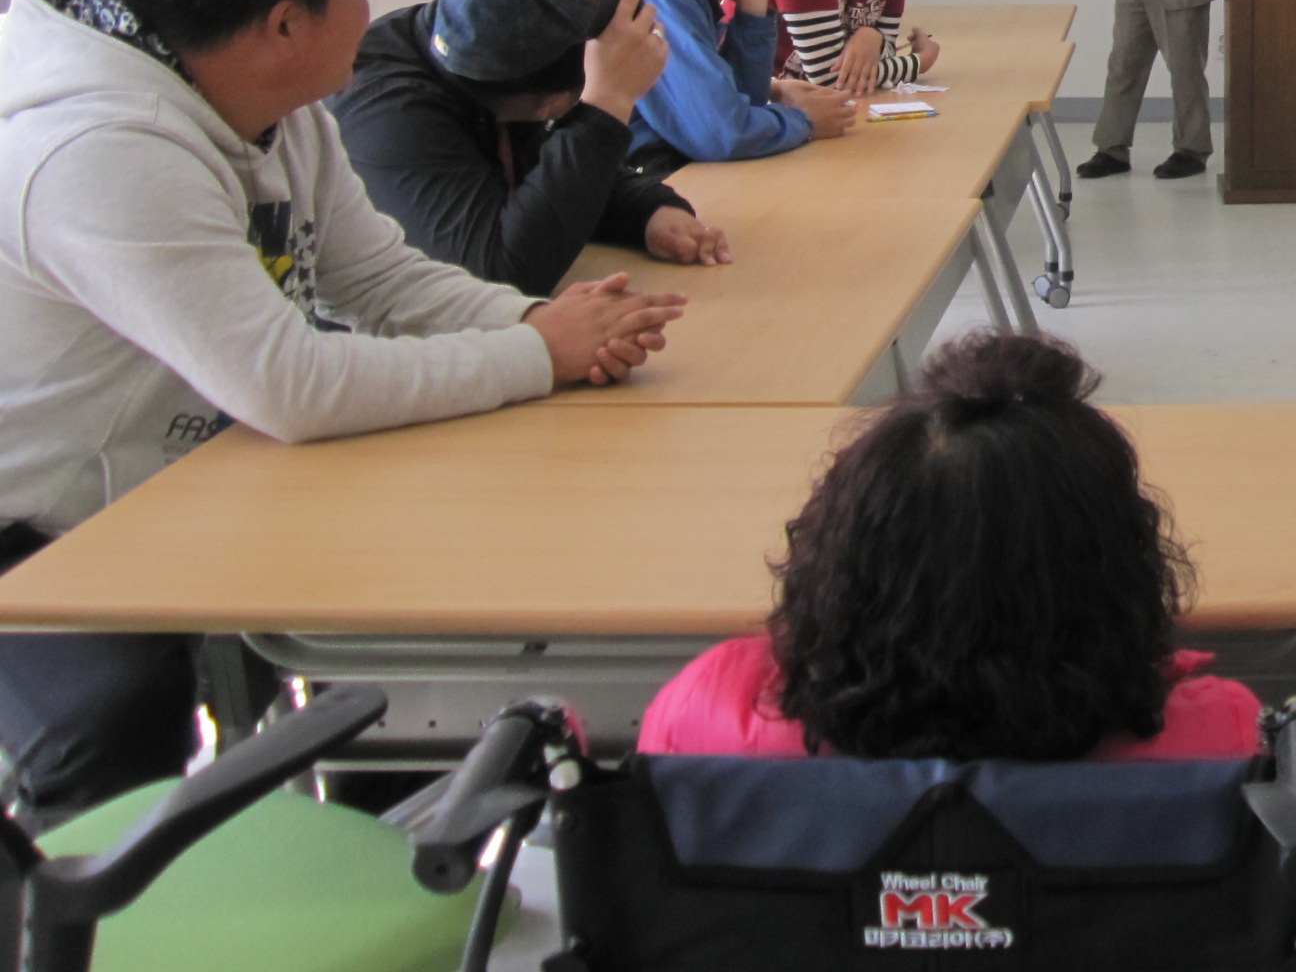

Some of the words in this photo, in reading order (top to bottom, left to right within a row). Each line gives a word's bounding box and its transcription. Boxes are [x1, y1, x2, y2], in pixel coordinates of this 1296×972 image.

[880, 872, 937, 891] Wheel
[941, 873, 989, 891] Chair
[879, 891, 989, 929] MK
